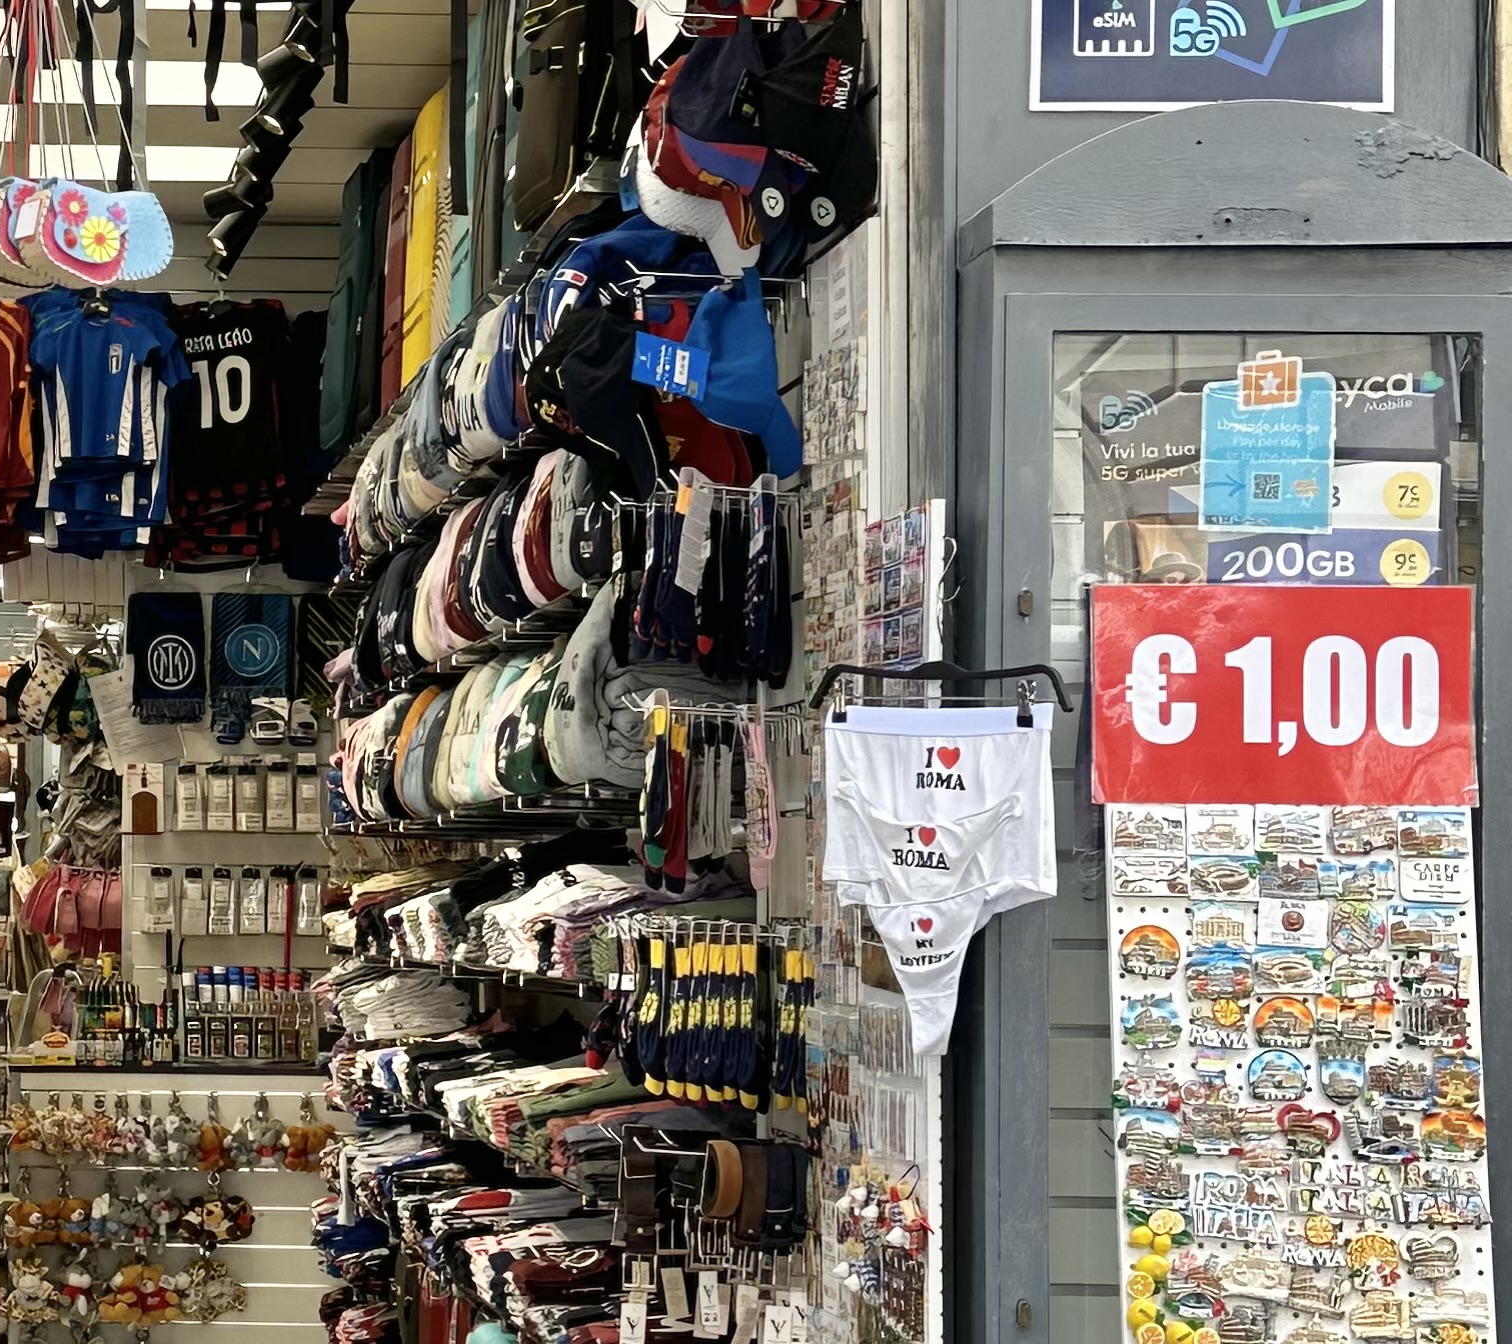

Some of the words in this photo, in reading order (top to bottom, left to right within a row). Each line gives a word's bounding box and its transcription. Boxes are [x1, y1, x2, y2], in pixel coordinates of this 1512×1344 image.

[1093, 13, 1136, 28] eSIM
[1172, 18, 1218, 52] 5G
[192, 355, 251, 429] 10
[1338, 371, 1413, 408] yca
[1101, 443, 1134, 460] Vivi
[1142, 443, 1160, 457] la
[1166, 443, 1196, 457] tua
[1101, 466, 1129, 481] 5G
[1222, 542, 1355, 582] 200GB
[1125, 633, 1198, 745] €
[1224, 634, 1440, 757] 1,00
[925, 747, 935, 768] I
[916, 772, 966, 791] ROMA
[905, 827, 914, 843] I
